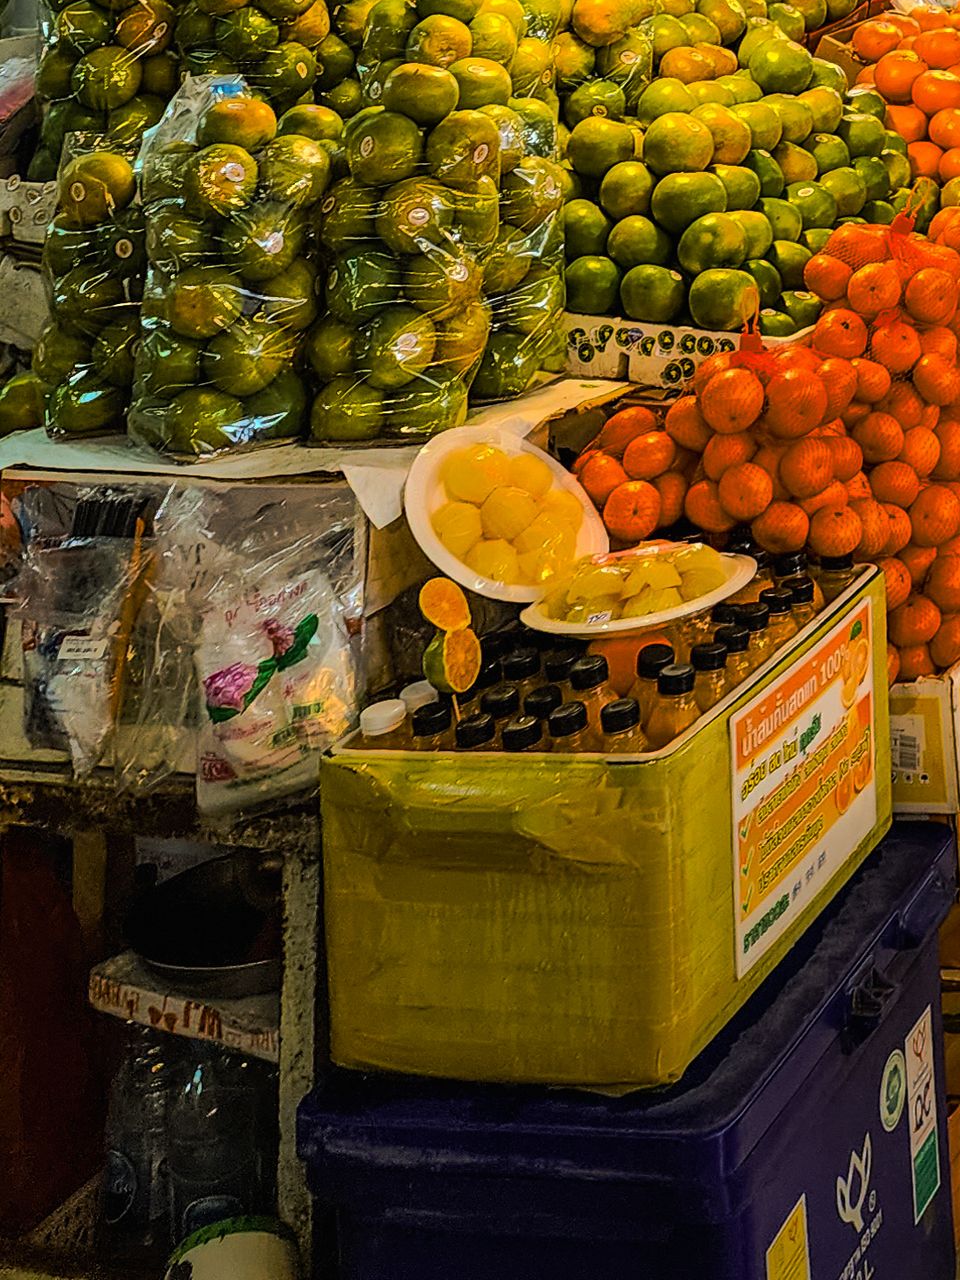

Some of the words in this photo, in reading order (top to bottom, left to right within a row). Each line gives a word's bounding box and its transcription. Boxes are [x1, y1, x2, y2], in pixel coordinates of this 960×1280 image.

[820, 643, 850, 686] 100%
[741, 758, 768, 802] อร่อย
[768, 749, 782, 775] สด
